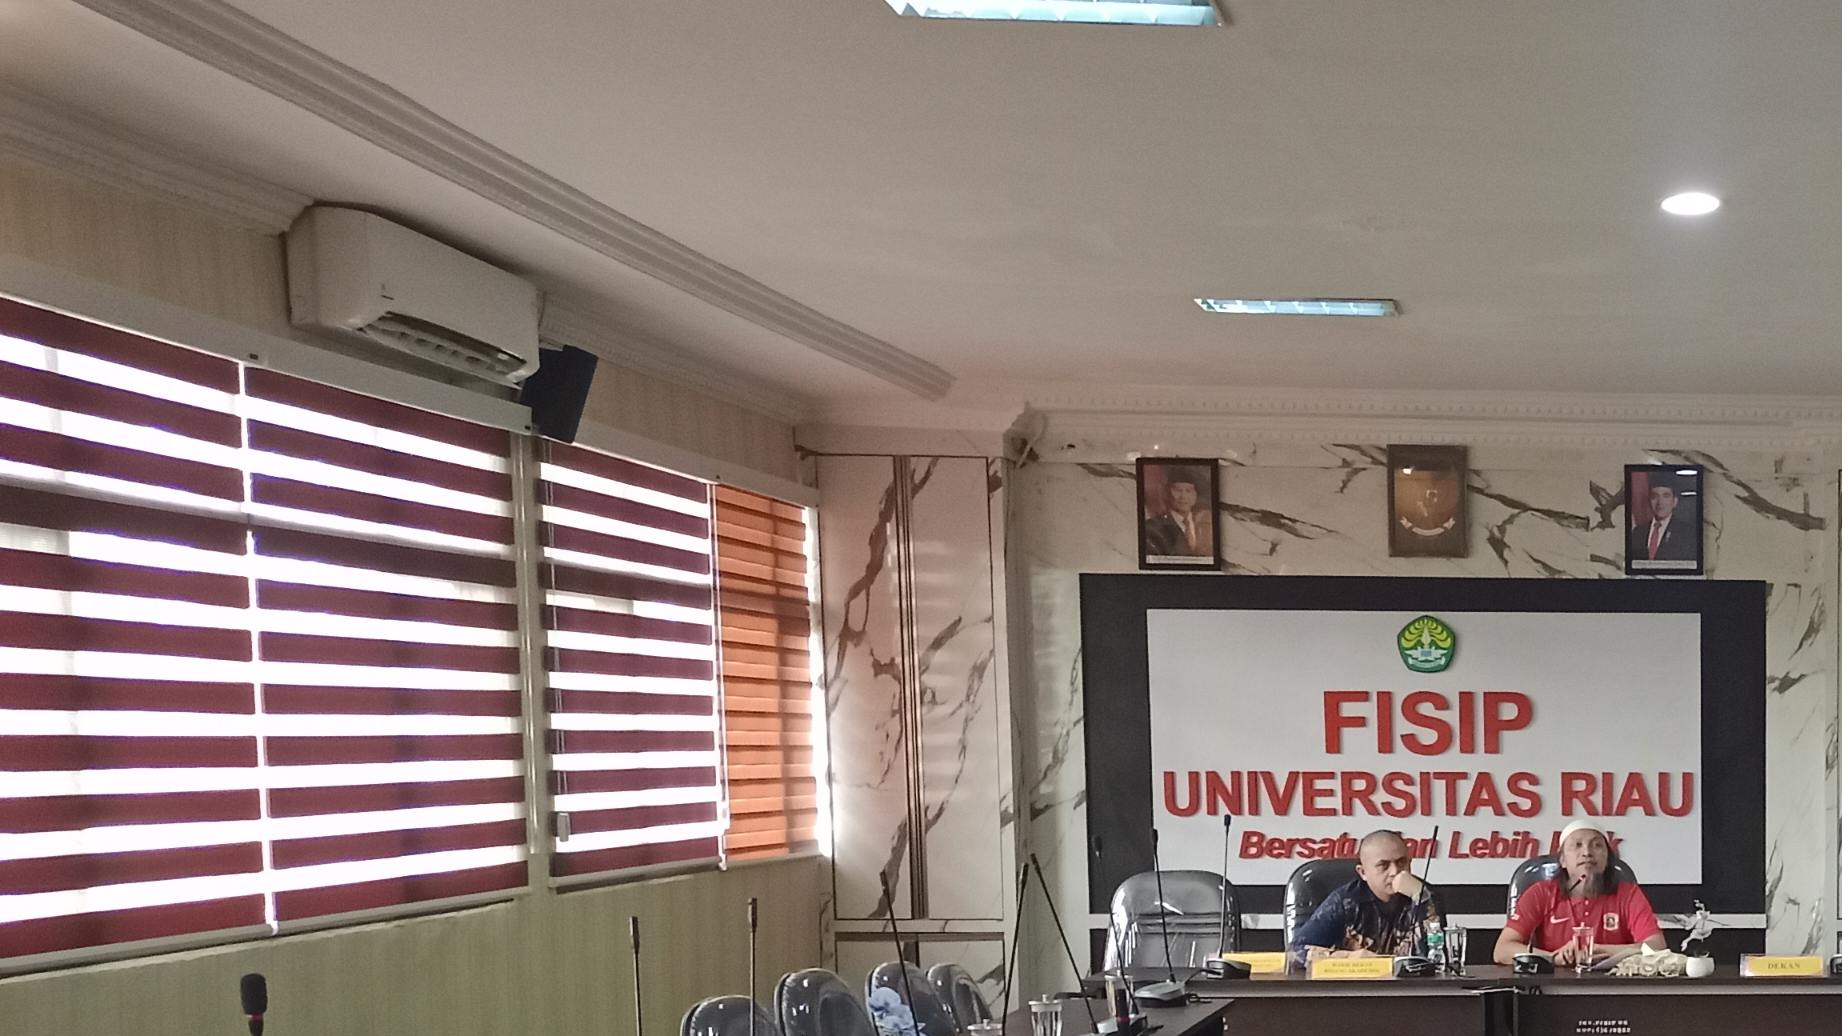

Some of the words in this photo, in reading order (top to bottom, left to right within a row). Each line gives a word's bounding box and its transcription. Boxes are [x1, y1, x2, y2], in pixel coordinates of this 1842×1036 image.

[1322, 689, 1534, 756] FISIP
[1162, 769, 1542, 818] UNIVERSITAS
[1560, 771, 1694, 818] RIAU
[1448, 830, 1541, 860] Lebih
